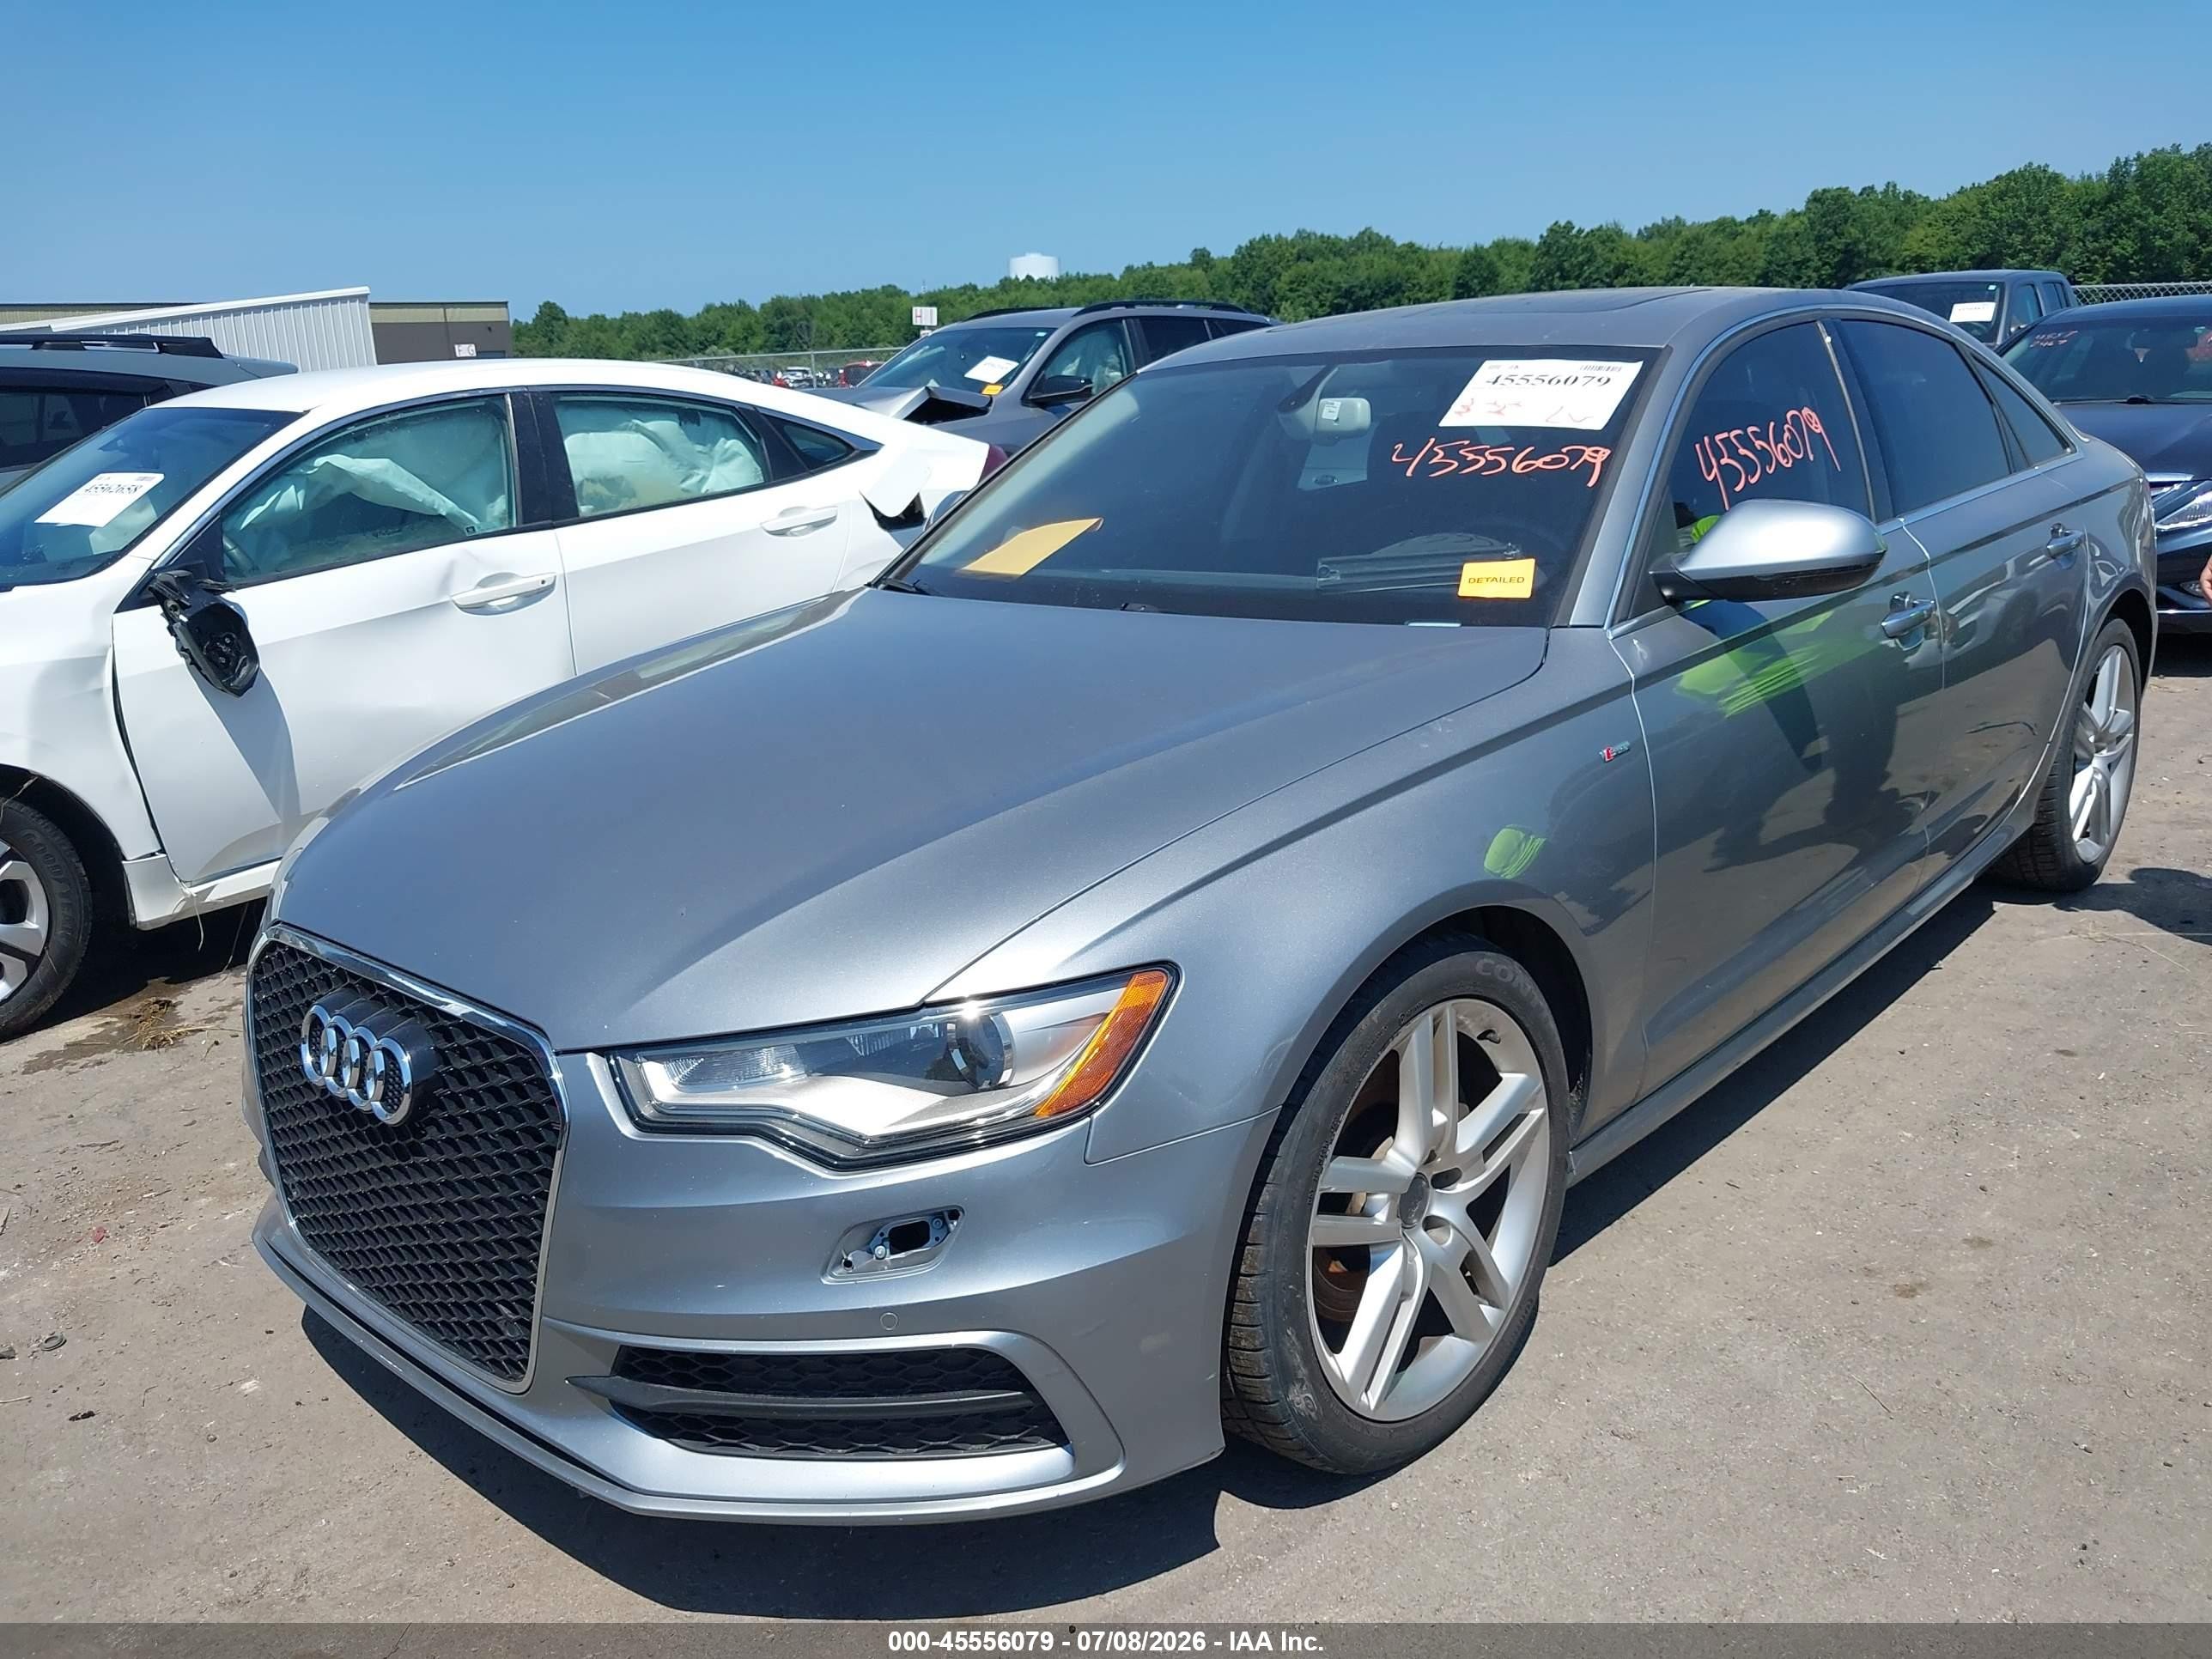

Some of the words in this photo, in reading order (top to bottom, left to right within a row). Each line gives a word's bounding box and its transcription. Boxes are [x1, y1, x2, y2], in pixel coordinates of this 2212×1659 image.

[1486, 374, 1612, 387] 45556079
[1391, 438, 1612, 488] 45556079
[1696, 407, 1841, 511] 45556079
[1468, 575, 1526, 585] DETAILED
